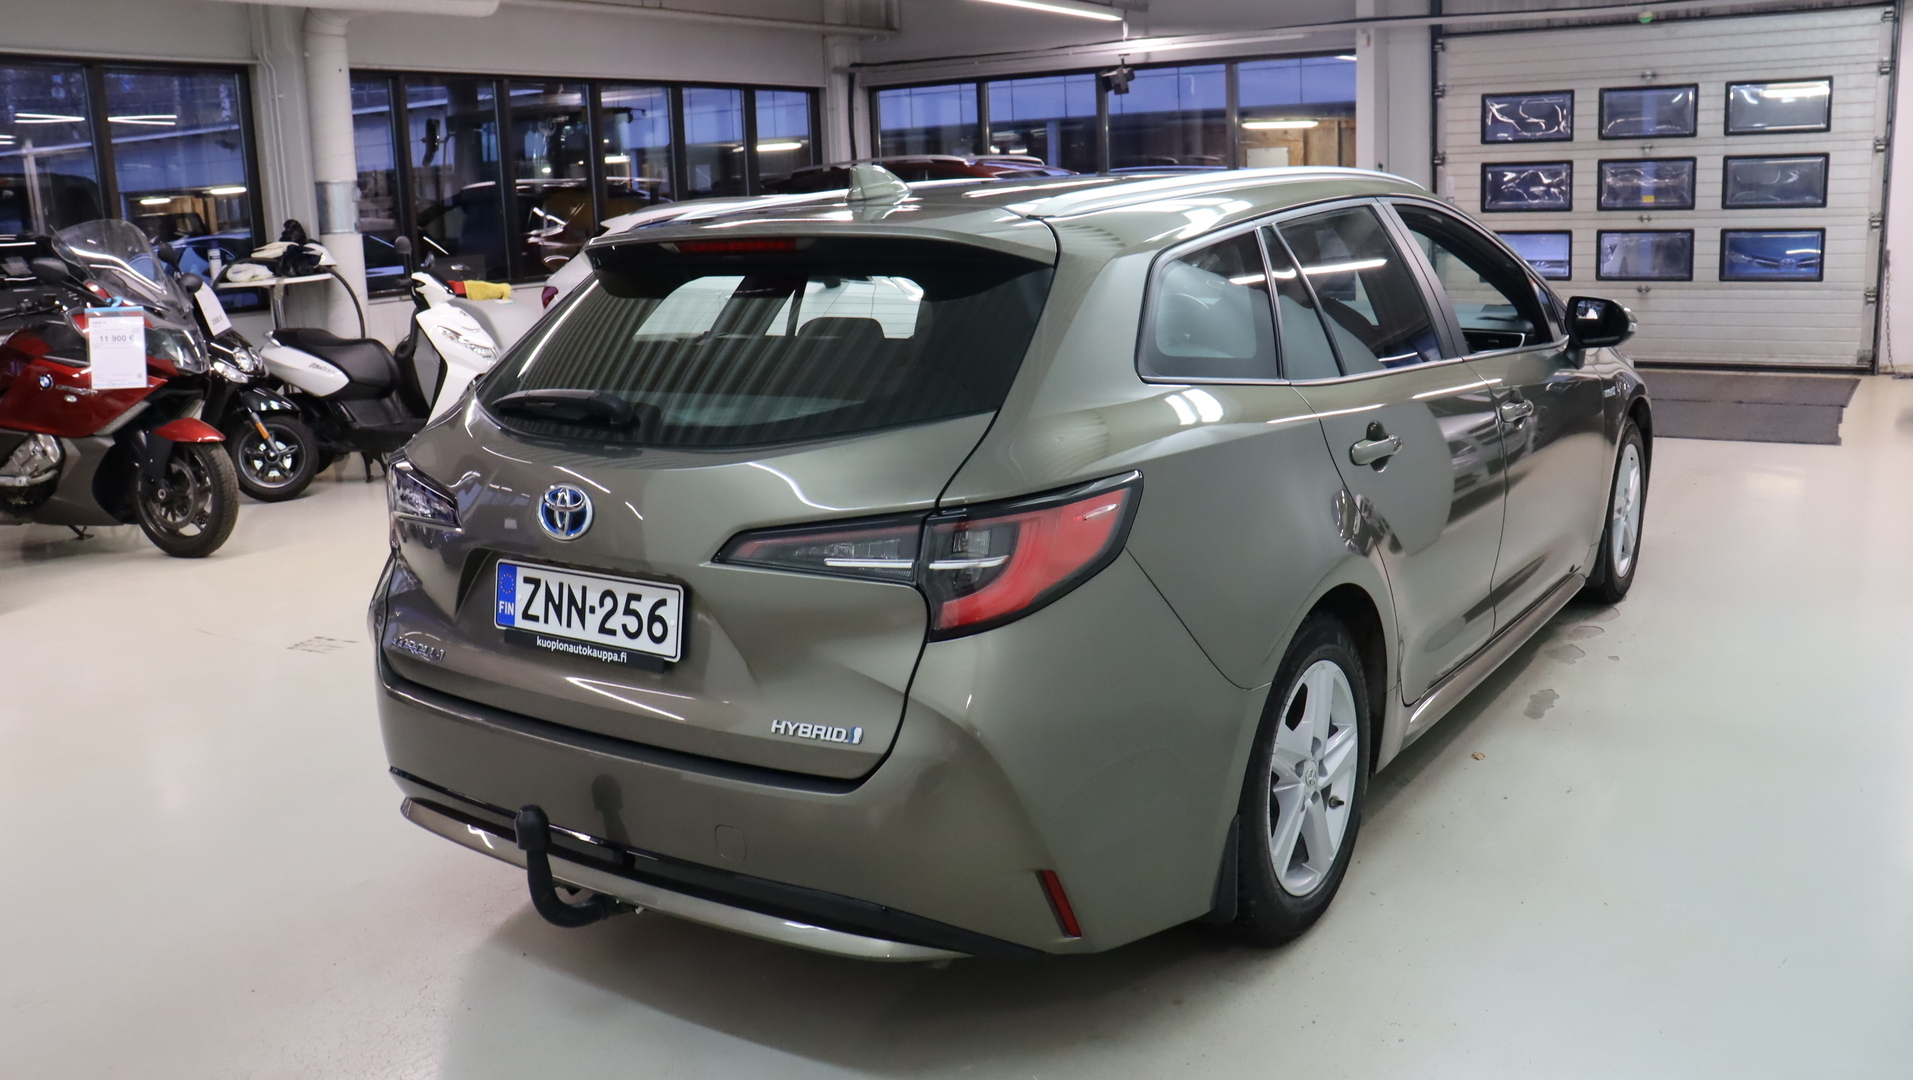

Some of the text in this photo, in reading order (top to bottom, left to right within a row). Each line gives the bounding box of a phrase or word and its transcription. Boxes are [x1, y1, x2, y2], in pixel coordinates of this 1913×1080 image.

[111, 334, 127, 342] 900
[498, 600, 515, 616] FIN
[521, 575, 669, 645] ZNN-256
[536, 635, 627, 663] kuopionautokauppa.fi
[771, 719, 848, 743] HYBRID
